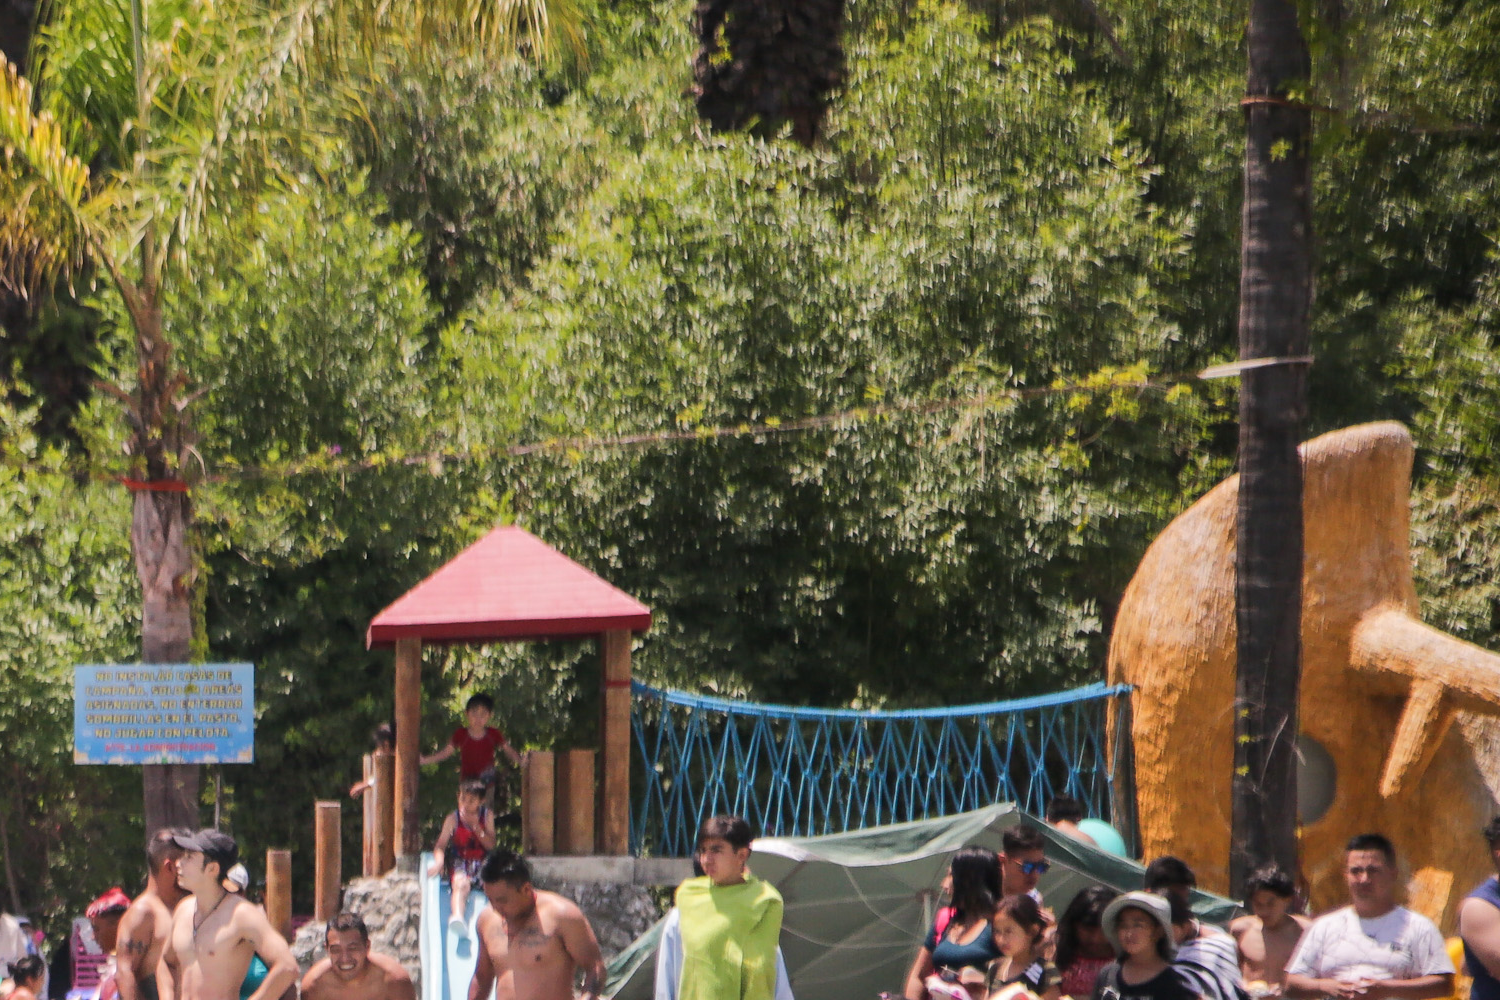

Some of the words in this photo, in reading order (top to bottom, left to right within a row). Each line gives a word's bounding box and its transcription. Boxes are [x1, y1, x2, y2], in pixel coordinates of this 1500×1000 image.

[96, 671, 113, 681] NO
[115, 671, 173, 681] INSTALAR
[176, 671, 214, 681] CASAS
[216, 671, 232, 681] DE
[152, 686, 182, 696] SOLO
[161, 700, 177, 710] NO
[180, 700, 242, 710] ENTERRAR
[86, 714, 162, 725] SOMBRILLAS
[164, 714, 180, 724] EN
[183, 714, 195, 724] EL
[95, 728, 111, 738] NO
[114, 728, 155, 738] JUGAR
[158, 728, 181, 738] CON
